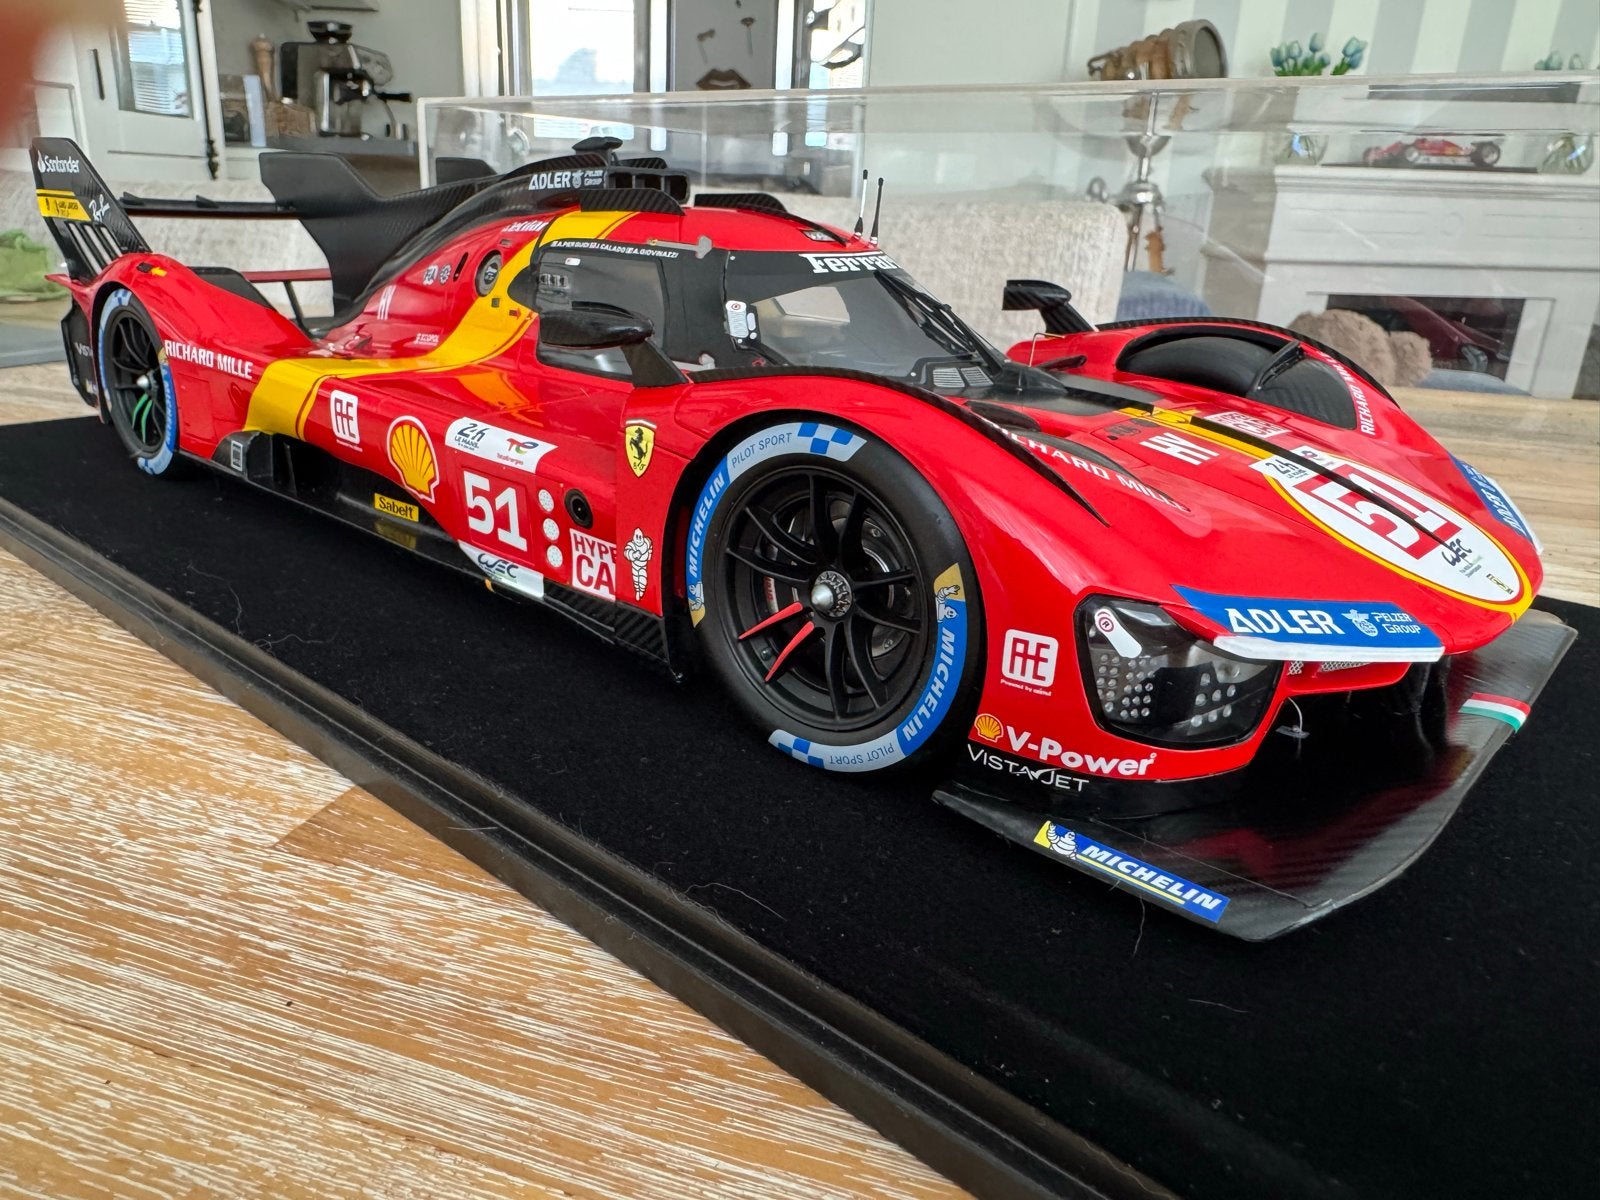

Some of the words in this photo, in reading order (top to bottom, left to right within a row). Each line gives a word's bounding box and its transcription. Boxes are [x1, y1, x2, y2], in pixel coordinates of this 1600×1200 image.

[528, 171, 571, 190] ADLER
[164, 340, 214, 368] RICHARD
[216, 353, 253, 379] MILLE
[1349, 384, 1376, 436] RICHARD
[731, 443, 756, 469] PILOT
[758, 432, 793, 451] SPORT
[379, 496, 413, 519] Sabelt
[463, 470, 528, 552] 51
[688, 471, 725, 579] MICHELIN
[1292, 463, 1462, 560] 51
[477, 553, 519, 579] WEC
[576, 553, 615, 596] CA
[1225, 607, 1345, 635] ADLER
[1371, 611, 1413, 623] PELZER
[1383, 623, 1421, 635] GROUP
[902, 626, 956, 742] MICHELIN
[829, 755, 864, 765] SPORT
[867, 742, 895, 762] PILOT
[967, 743, 1090, 792] VISTAJET
[1007, 726, 1158, 776] V-Power
[1081, 844, 1223, 911] MICHELIN
